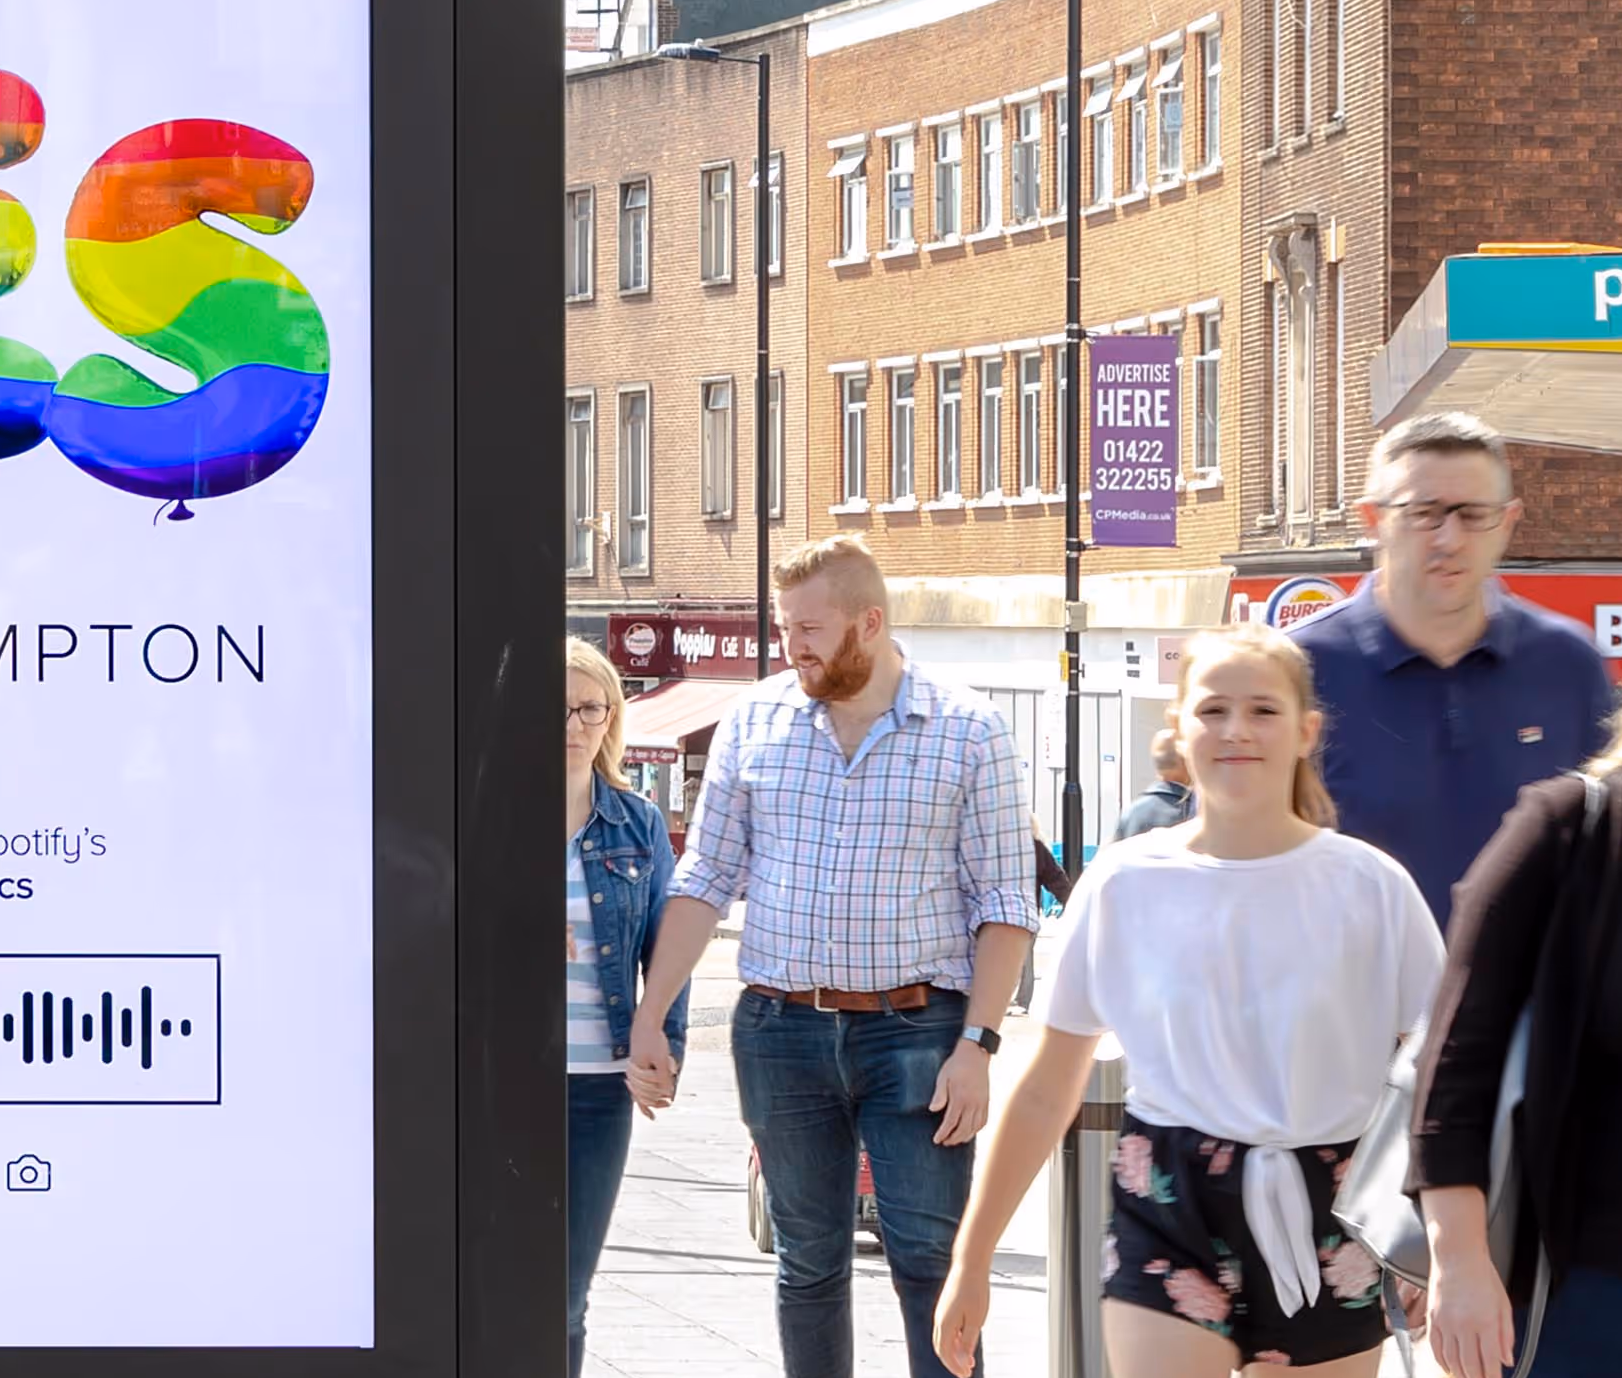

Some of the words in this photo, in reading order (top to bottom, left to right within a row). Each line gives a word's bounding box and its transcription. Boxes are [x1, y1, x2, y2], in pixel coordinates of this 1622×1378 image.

[1097, 364, 1171, 383] ADVERTISE
[1097, 389, 1171, 427] HERE
[1103, 440, 1163, 463] 01422
[1095, 468, 1172, 490] 322255
[1279, 603, 1332, 620] BUR
